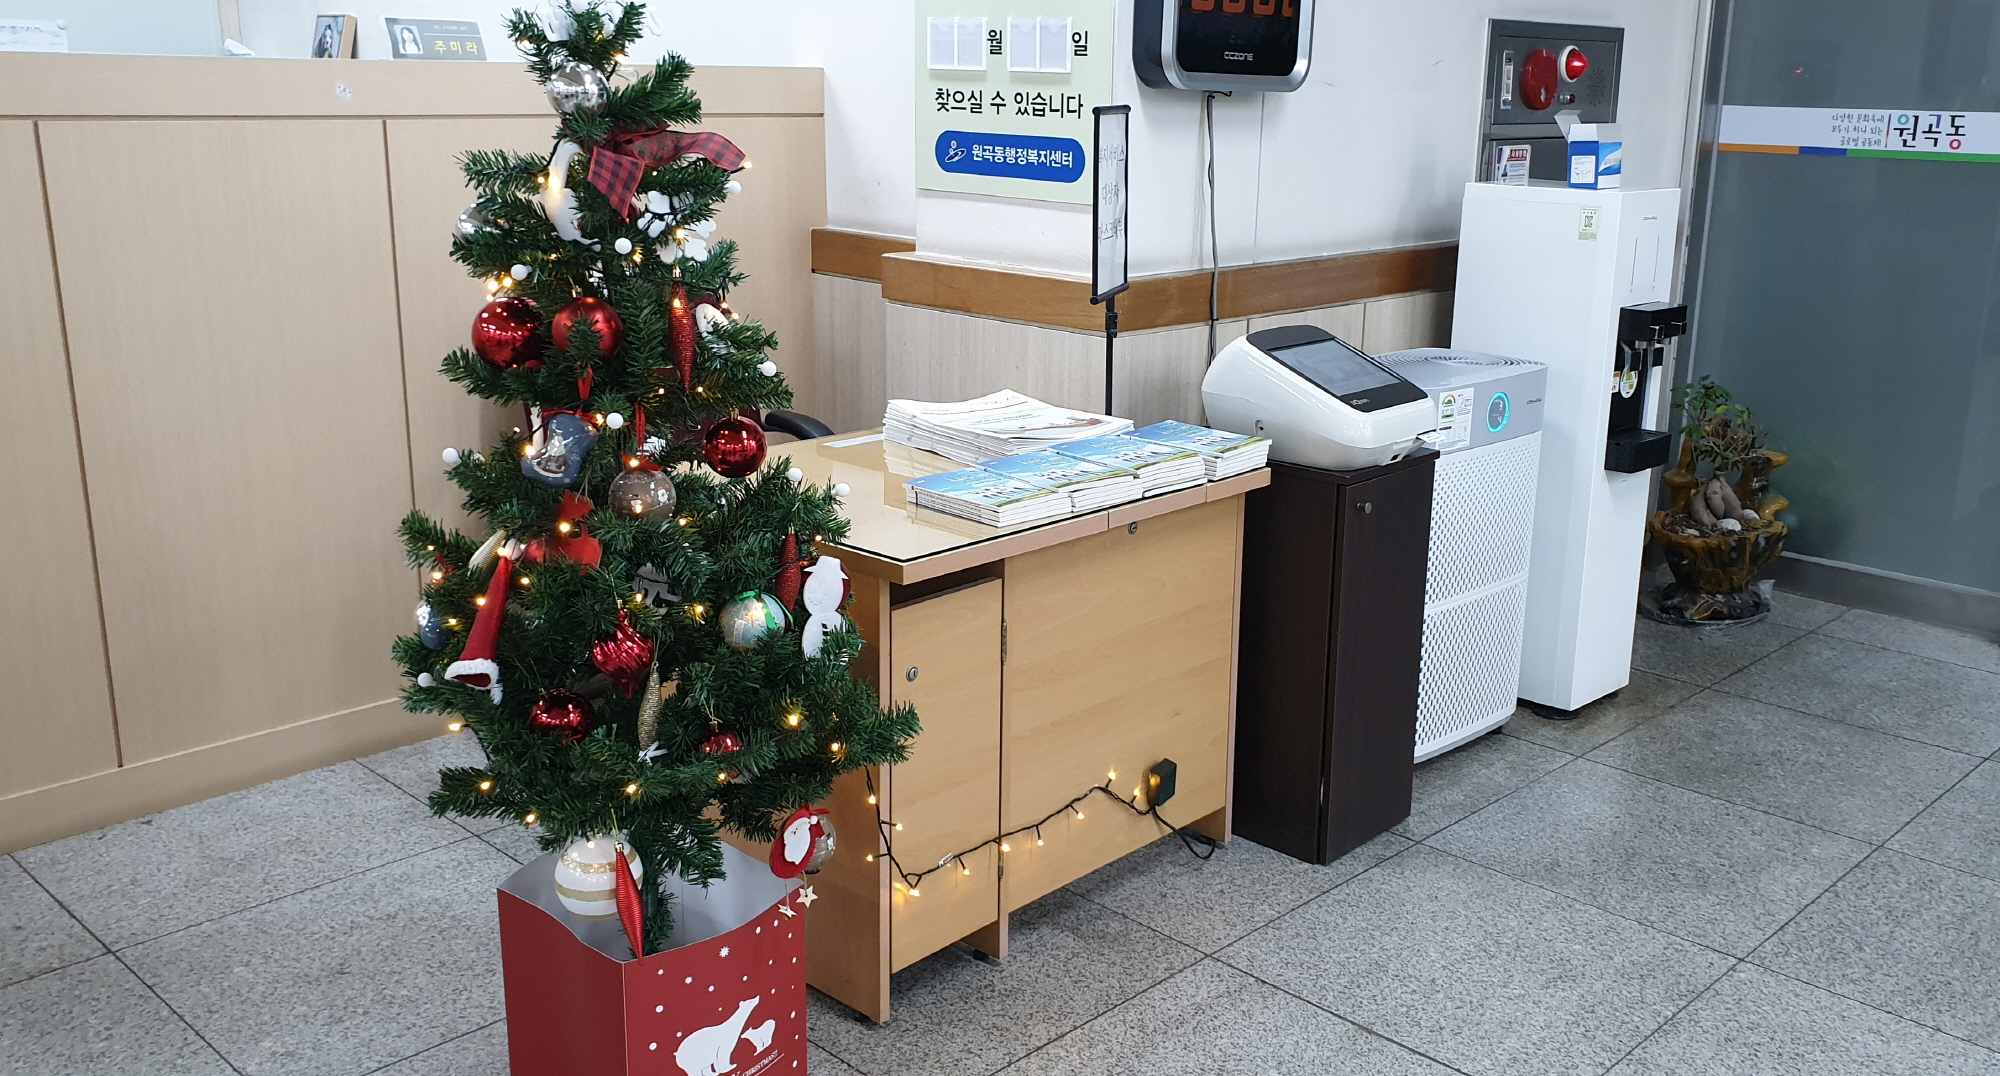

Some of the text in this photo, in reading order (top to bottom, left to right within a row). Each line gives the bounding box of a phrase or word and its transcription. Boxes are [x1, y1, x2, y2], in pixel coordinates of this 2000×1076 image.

[987, 29, 1088, 57] 월 일
[934, 87, 1084, 120] 찾으실 수 있습니다
[1893, 113, 1966, 151] 원곡동
[971, 144, 1073, 169] 원곡동행정복지센터
